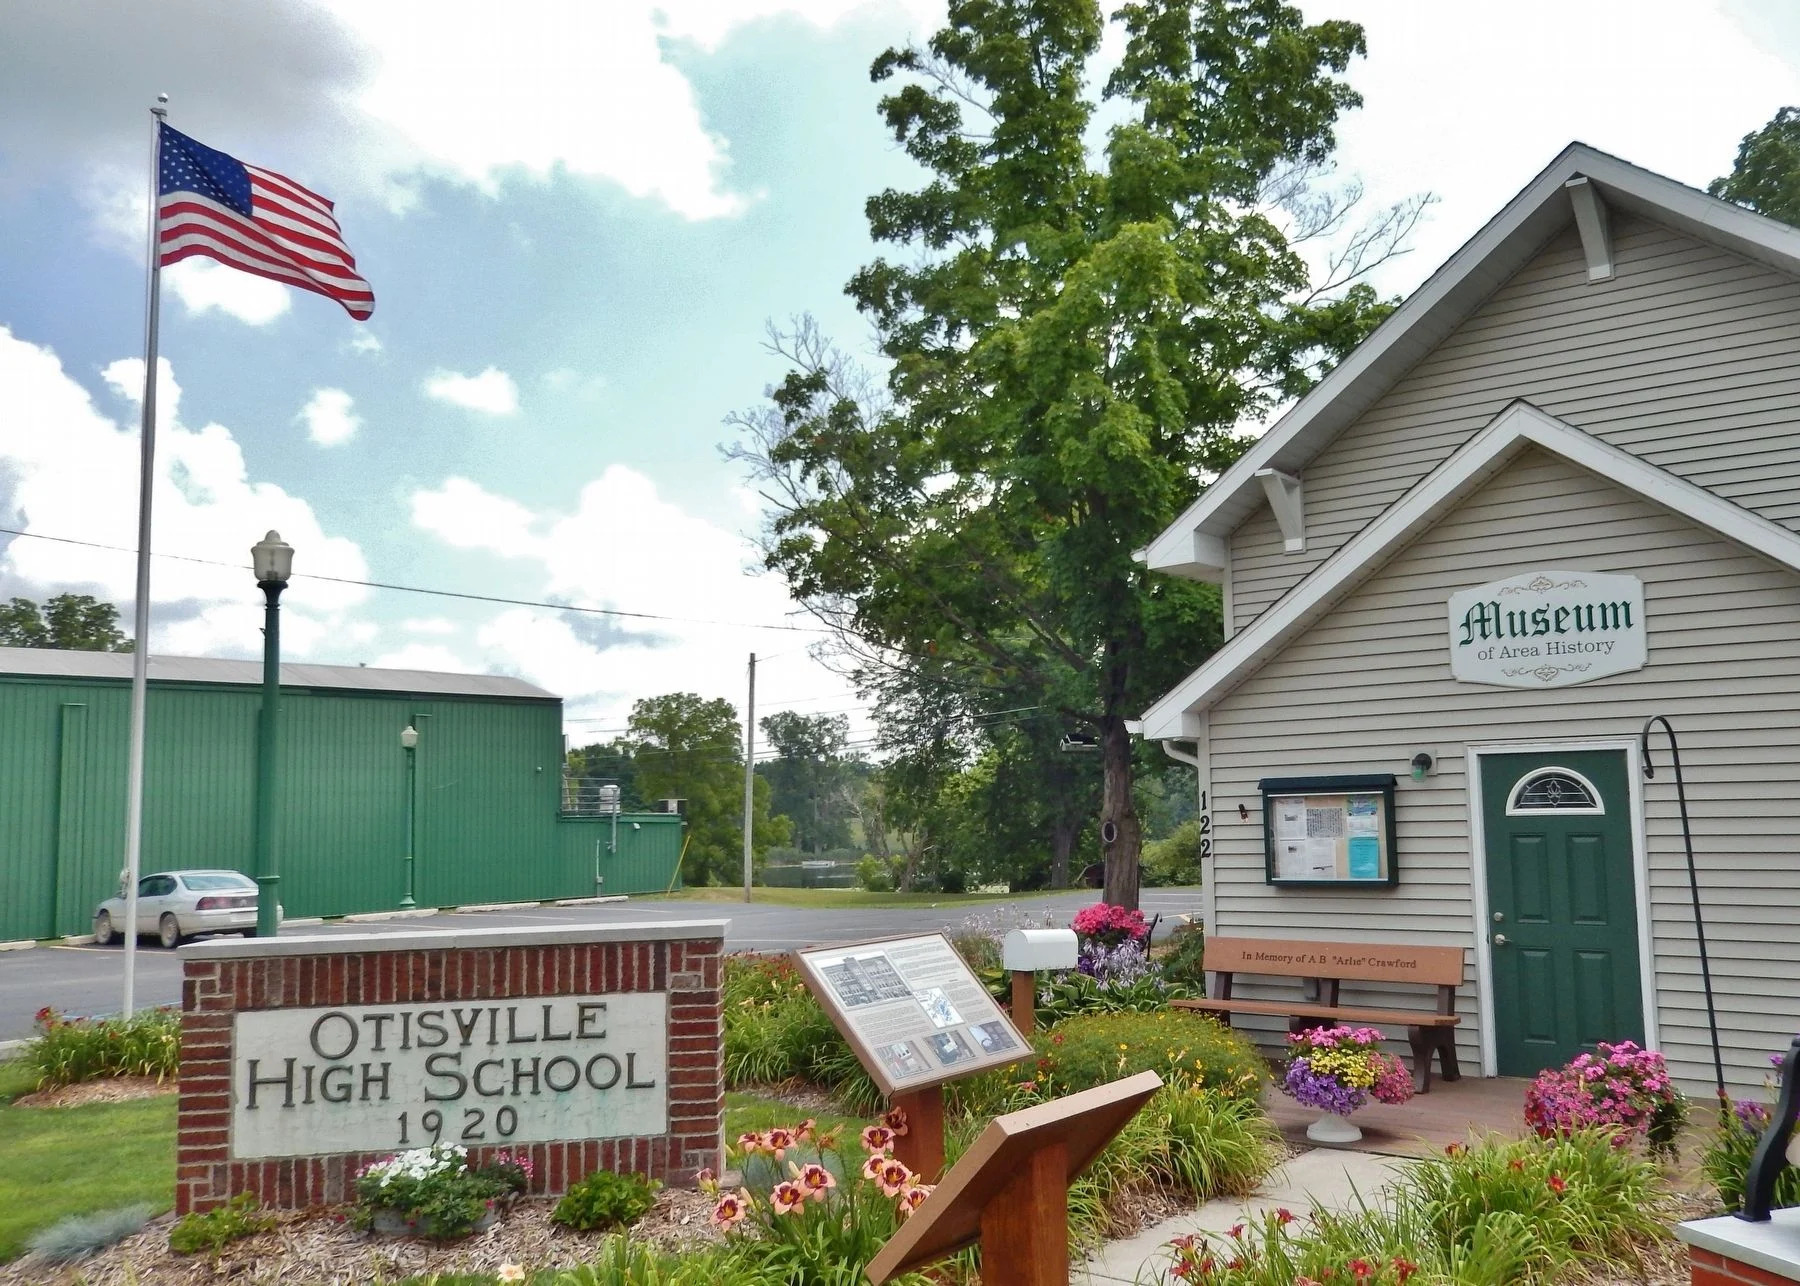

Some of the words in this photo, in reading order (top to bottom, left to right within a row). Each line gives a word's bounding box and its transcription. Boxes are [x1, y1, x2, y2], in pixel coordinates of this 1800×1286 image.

[1459, 601, 1634, 648] Museum
[1477, 647, 1495, 661] of
[1499, 645, 1541, 660] Area
[1546, 640, 1616, 656] History
[1200, 790, 1211, 858] 122
[1242, 951, 1251, 960] In
[1255, 952, 1293, 964] Memory
[1295, 954, 1306, 963] of
[1368, 958, 1417, 969] Crawford
[309, 1002, 607, 1061] OTISVILLE
[246, 1057, 392, 1110] HIGH
[424, 1051, 656, 1102] SCHOOL
[398, 1104, 519, 1146] 1920
